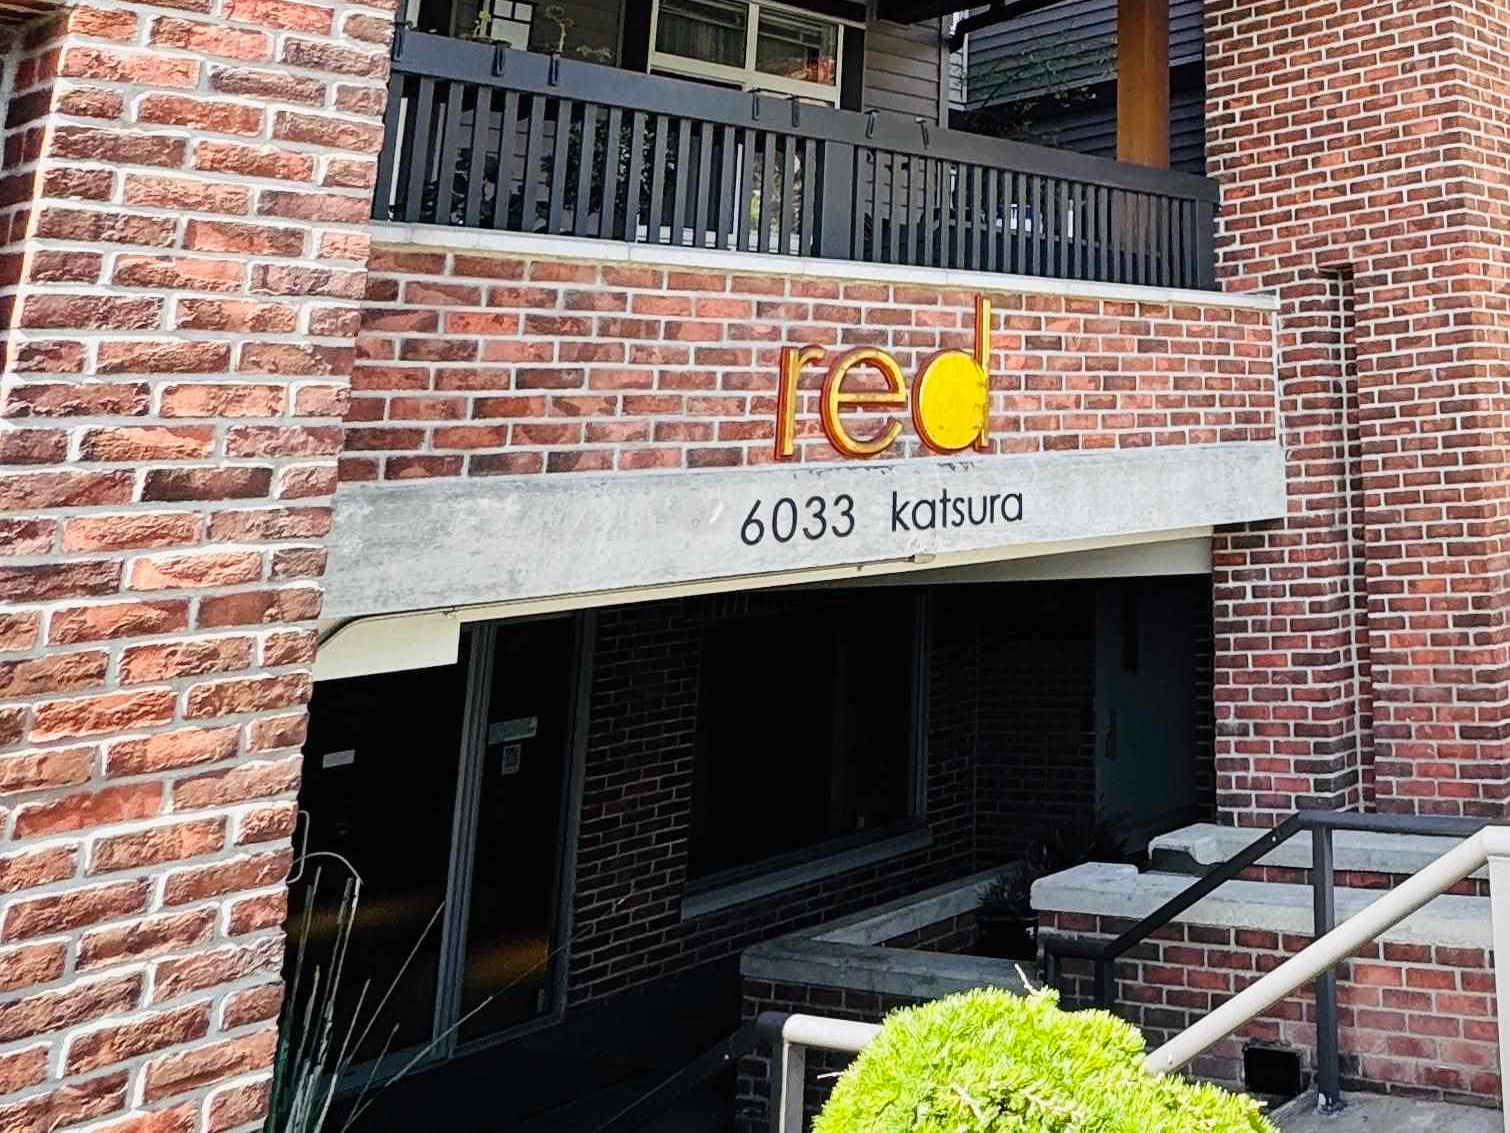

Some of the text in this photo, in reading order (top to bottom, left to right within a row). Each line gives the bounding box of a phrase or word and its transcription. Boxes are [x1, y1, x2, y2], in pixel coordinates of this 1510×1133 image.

[774, 293, 991, 460] red
[740, 488, 1023, 546] 6033 katsura
